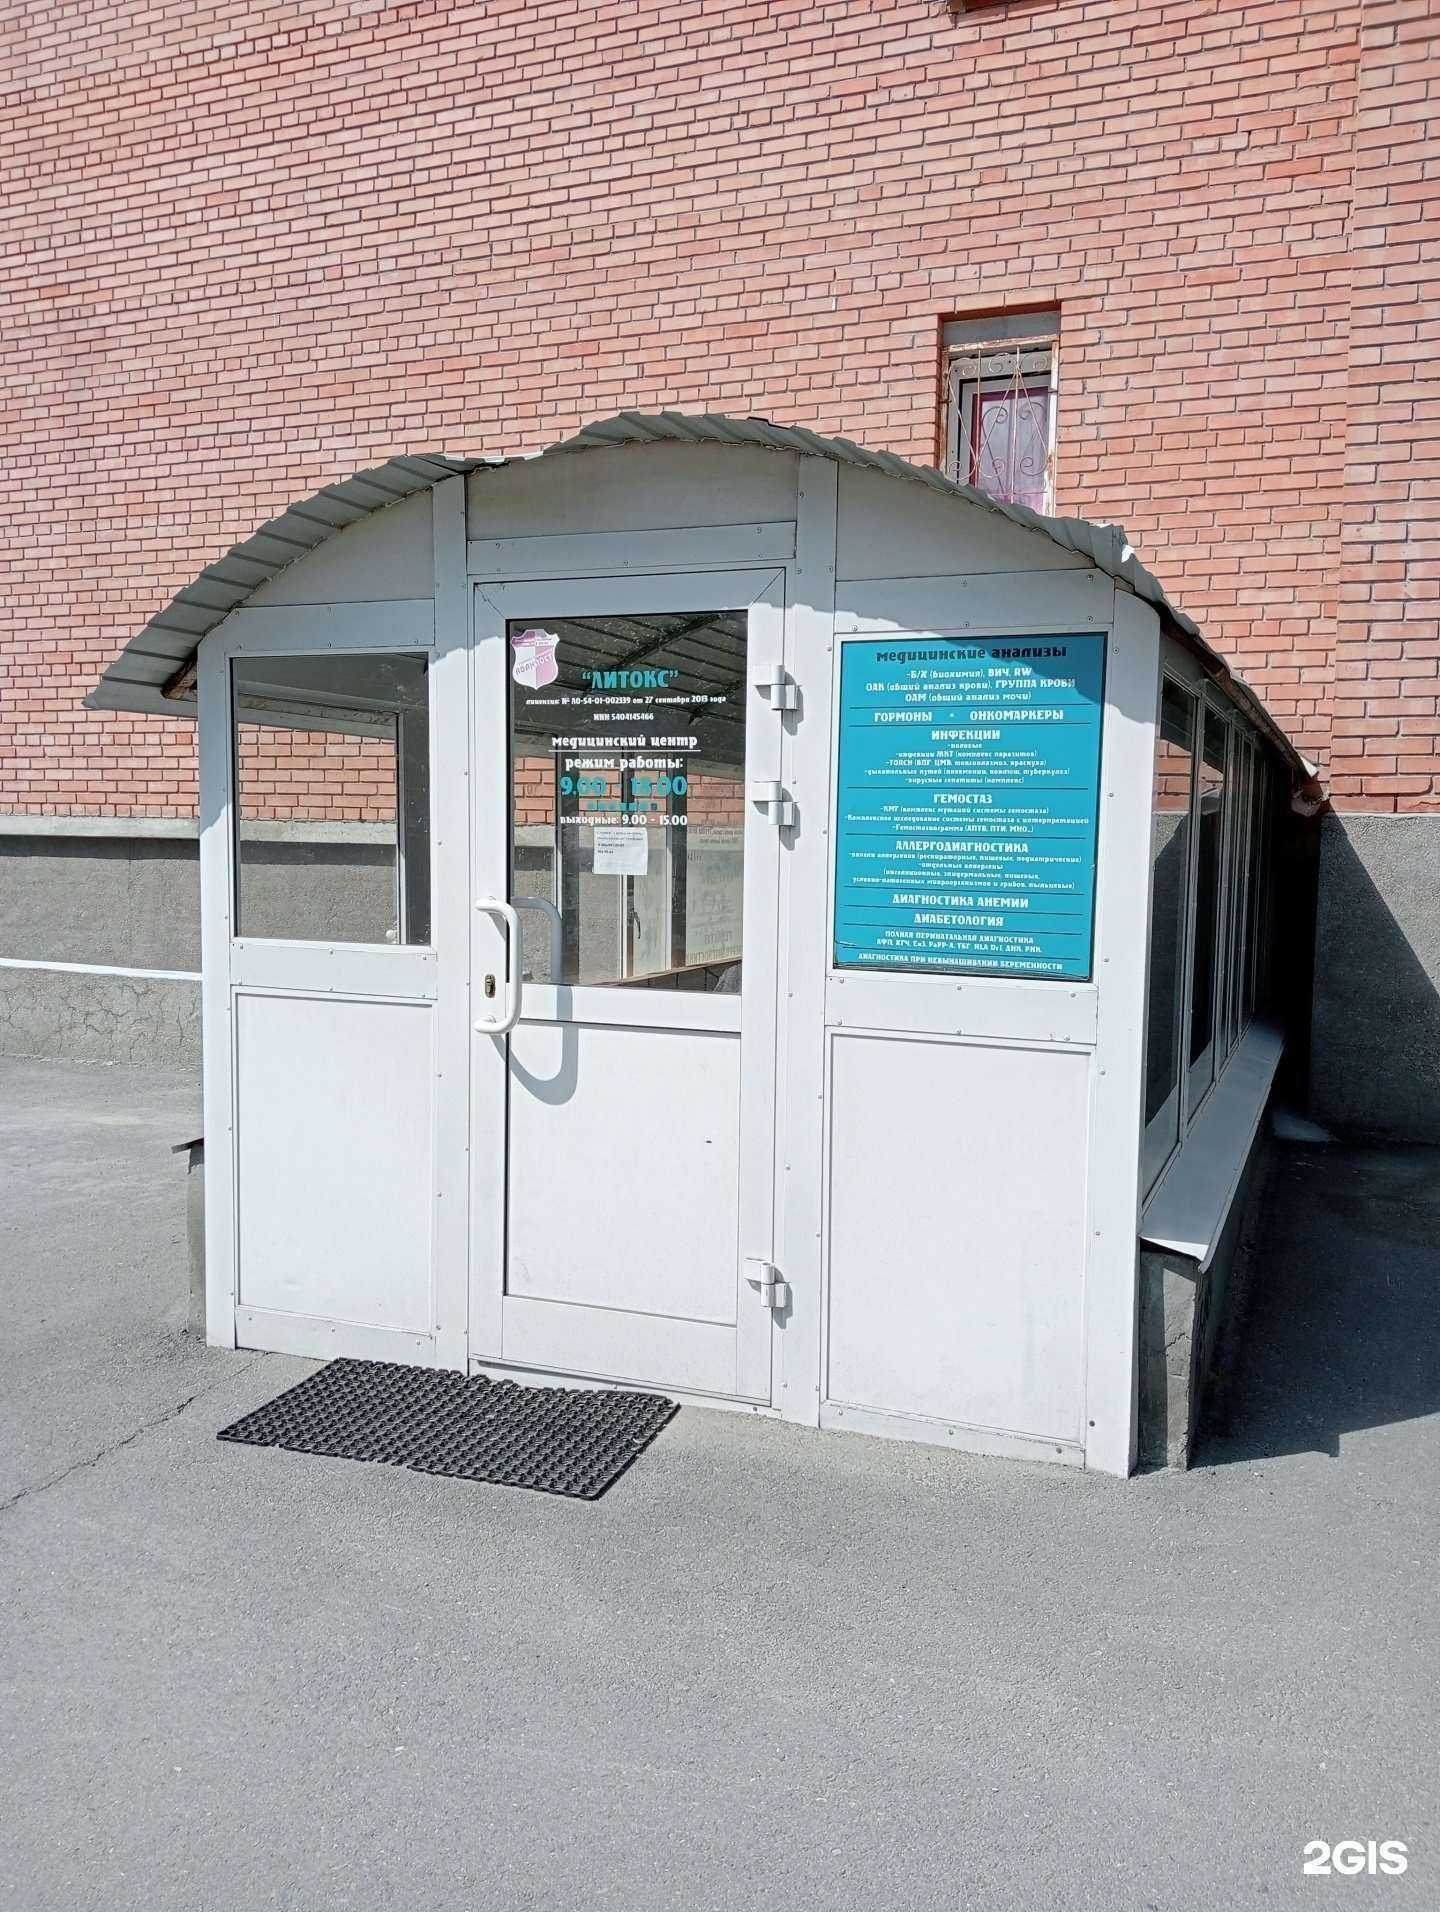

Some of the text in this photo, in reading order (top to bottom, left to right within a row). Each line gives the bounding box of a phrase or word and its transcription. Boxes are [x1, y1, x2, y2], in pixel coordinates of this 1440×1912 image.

[876, 646, 1067, 664] медицинские анализы
[1014, 667, 1033, 677] RW
[866, 682, 885, 692] ОАК
[923, 682, 956, 690] анализ
[995, 679, 1037, 689] ГРУППА
[1040, 678, 1076, 688] КРОВИ
[645, 696, 654, 704] 27
[655, 695, 690, 705] сентября
[691, 695, 708, 703] 2013
[710, 696, 727, 704] года
[905, 693, 927, 702] ОАМ
[965, 693, 1000, 701] анализ
[1002, 691, 1032, 701] мочи)
[593, 713, 610, 721] ИНН
[874, 709, 1064, 722] ГОРМОНЫ ОНКОМАРКЕРЫ
[551, 734, 698, 749] медицинский центр
[931, 729, 1000, 741] ИНФЕКЦИИ
[936, 750, 954, 758] ЖКТ
[565, 755, 684, 771] режим работы:
[1010, 759, 1047, 767] краснуха)
[919, 768, 942, 776] путей
[984, 776, 1025, 784] (комплекс)
[933, 793, 993, 804] ГЕМОСТАЗ
[560, 815, 619, 827] выходные:
[622, 814, 648, 825] 9.00
[659, 814, 688, 826] 15.00
[896, 840, 1029, 853] АЛЛЕРГОДИАГНОСТИКА
[892, 894, 1029, 908] ДИАГНОСТИКА АНЕМИИ
[914, 913, 1004, 926] ДИАБЕТОЛОГИЯ
[885, 930, 1034, 944] ПОЛНАЯ ПЕРИНАТАЛЬНАЯ ДИАГНОСТИКА
[858, 952, 909, 962] ДИАГНОСТИКА
[1000, 960, 1063, 970] БЕРЕМЕННОСТИ
